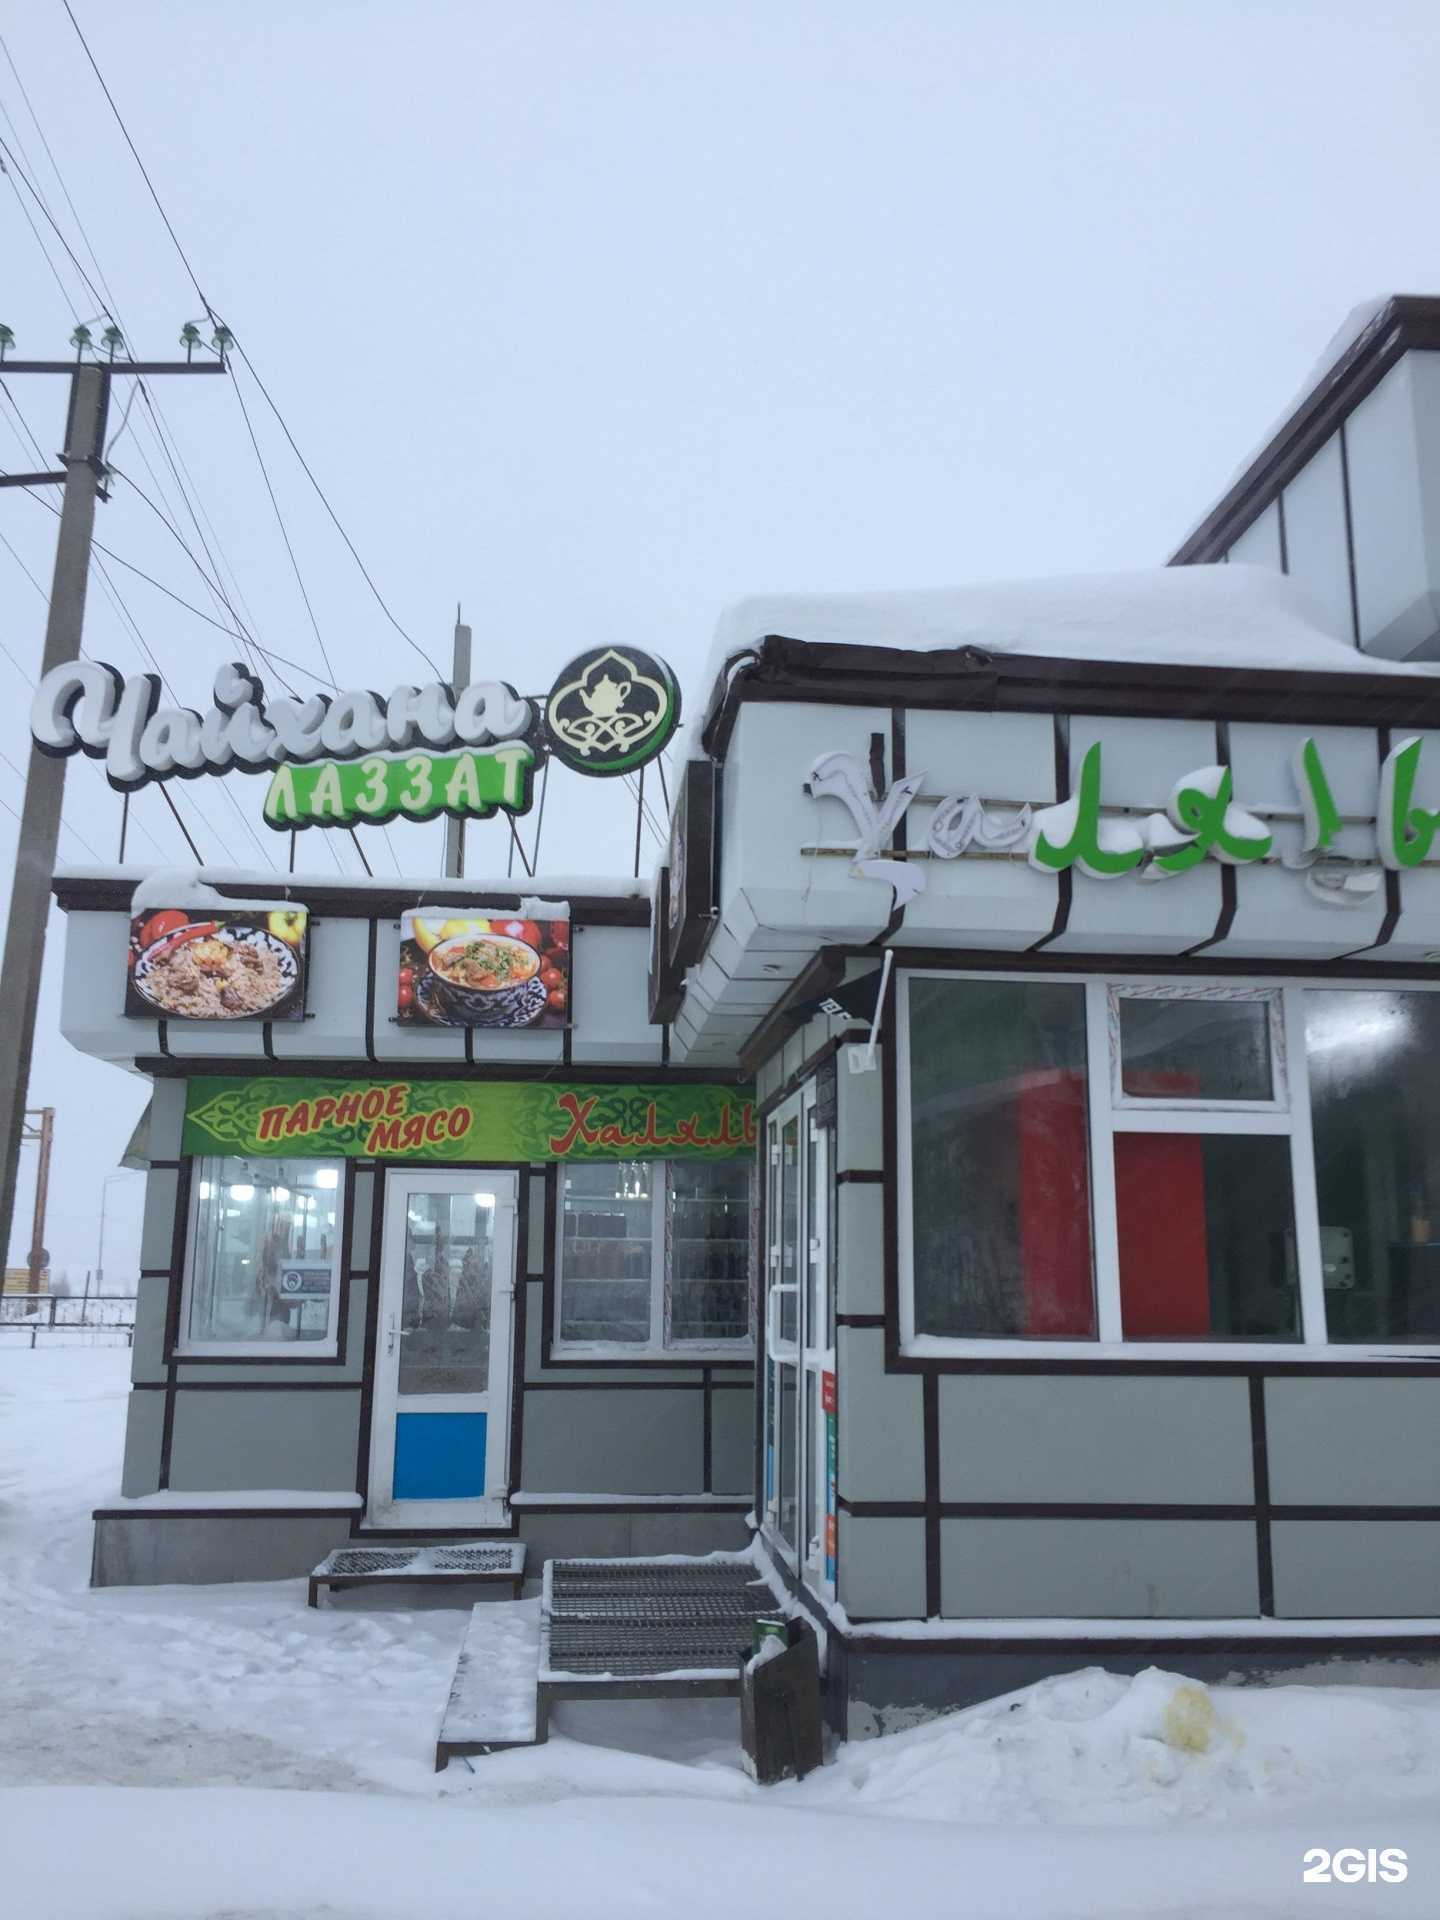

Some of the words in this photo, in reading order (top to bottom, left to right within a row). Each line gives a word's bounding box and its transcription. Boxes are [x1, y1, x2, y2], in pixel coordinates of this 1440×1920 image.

[31, 661, 532, 787] Чайхана
[265, 752, 532, 820] ЛАЗЗАТ
[258, 1084, 409, 1140] ПАРНОЕ
[366, 1106, 473, 1155] МЯСО
